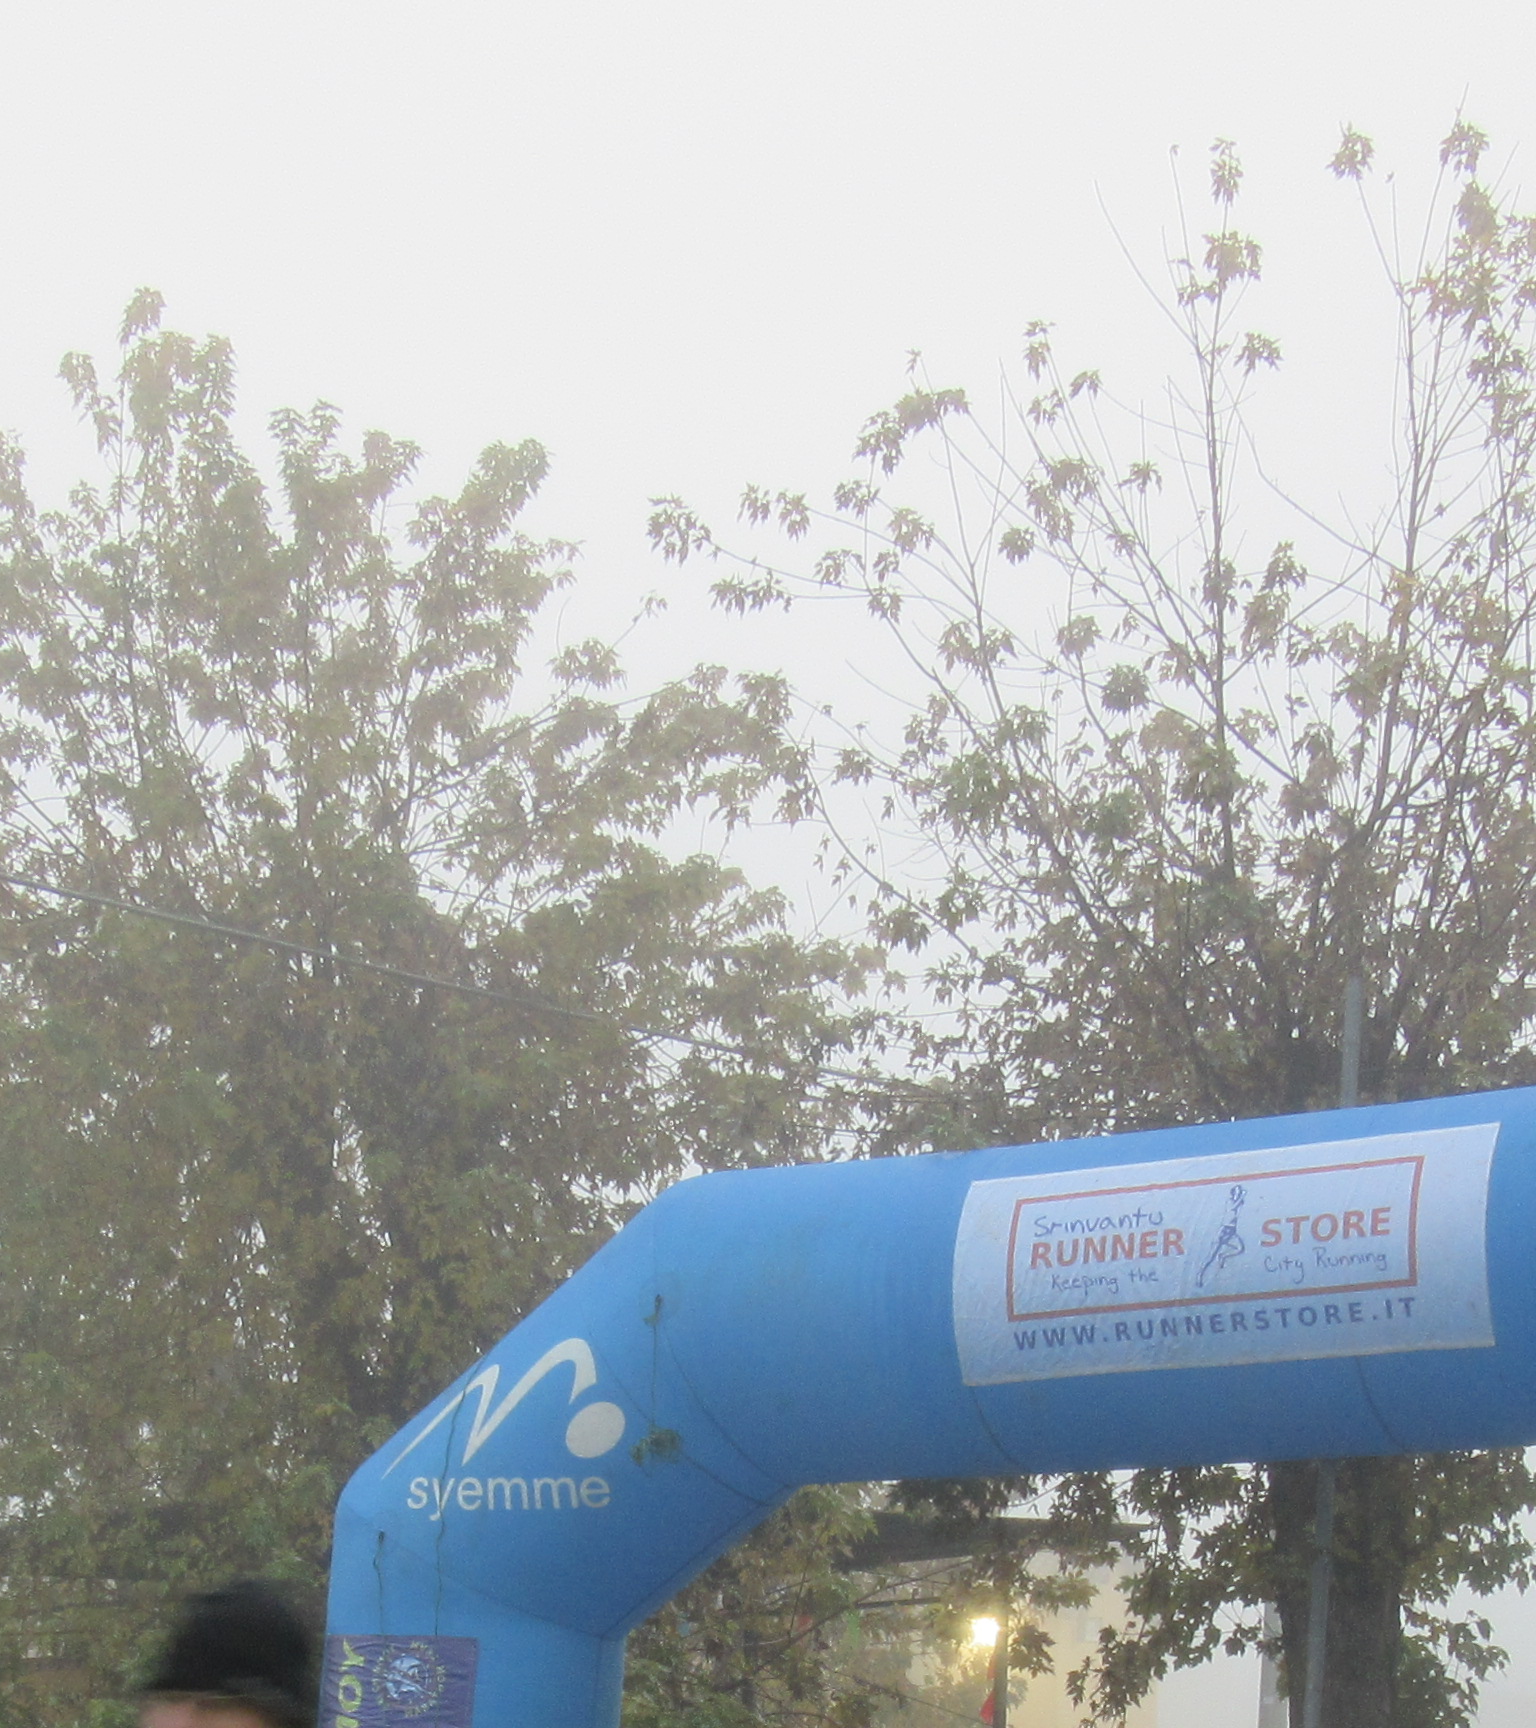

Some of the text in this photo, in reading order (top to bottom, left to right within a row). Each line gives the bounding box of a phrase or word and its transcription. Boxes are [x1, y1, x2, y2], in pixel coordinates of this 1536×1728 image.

[1030, 1206, 1392, 1270] RUNNER STORE
[1051, 1246, 1388, 1296] Keeping the City Running
[1013, 1296, 1416, 1350] WWW.RUNNERSTORE.IT
[406, 1474, 612, 1521] syemme
